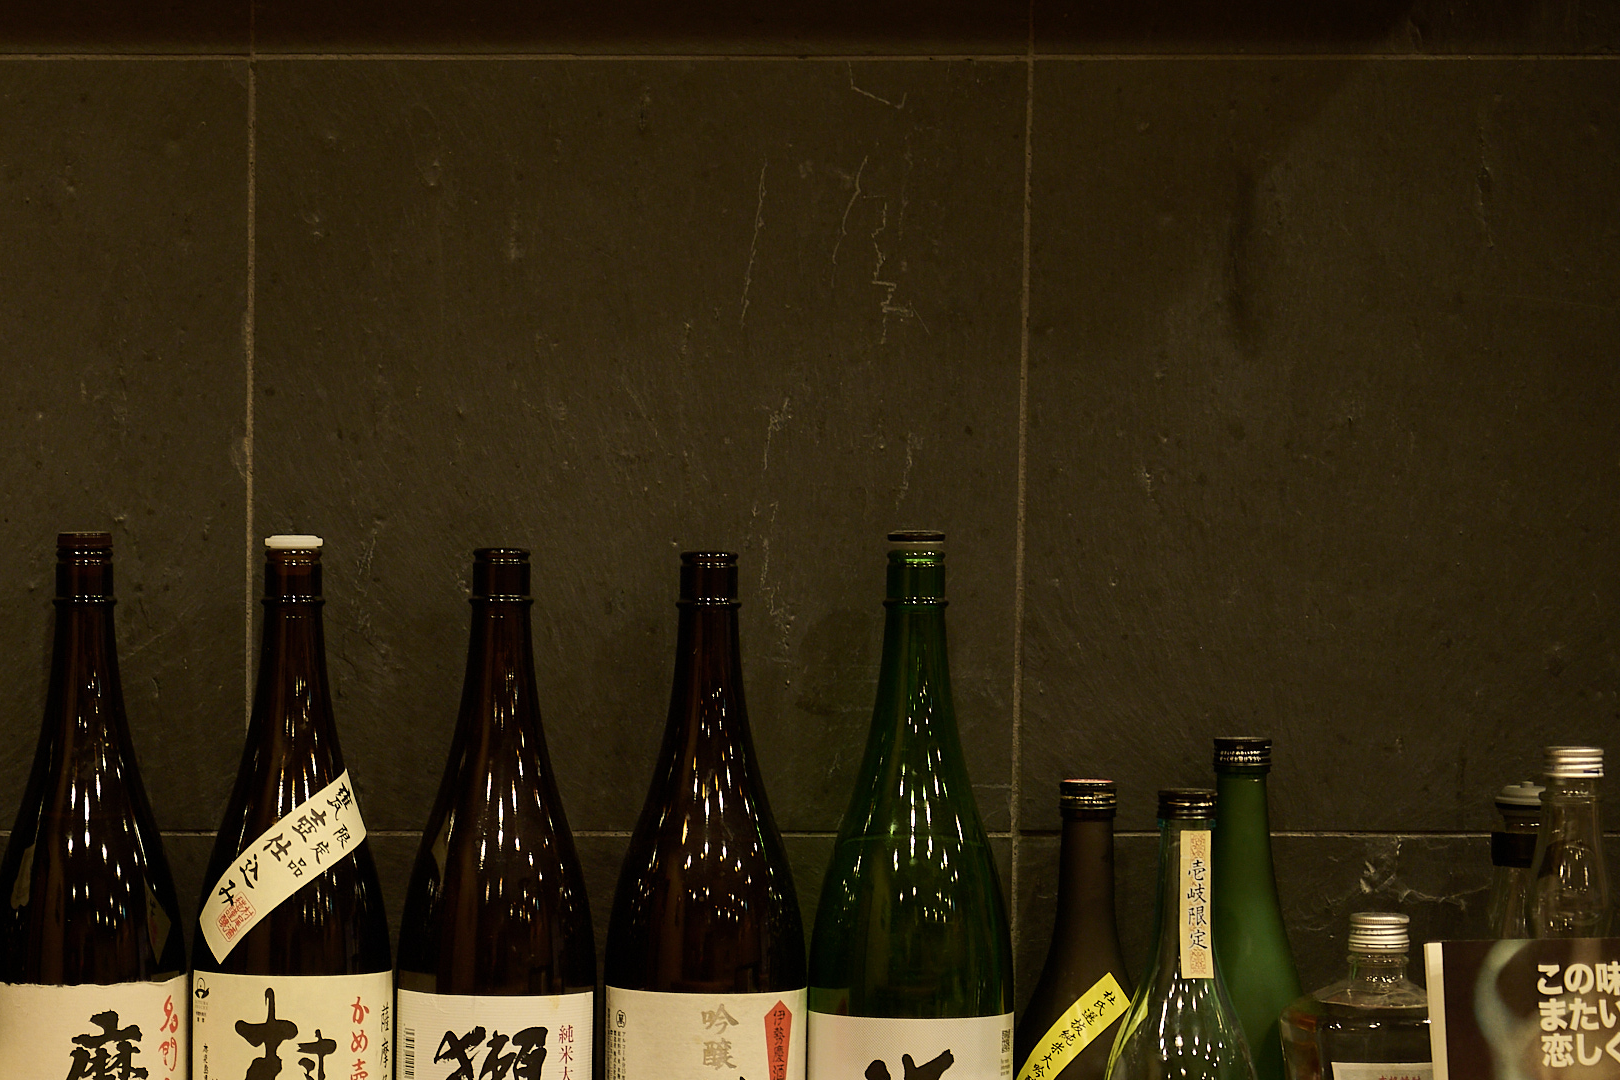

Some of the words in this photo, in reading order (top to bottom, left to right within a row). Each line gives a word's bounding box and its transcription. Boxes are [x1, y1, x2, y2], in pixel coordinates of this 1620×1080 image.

[286, 824, 351, 878] 限定品
[1186, 859, 1208, 951] 壱岐限定
[1537, 960, 1620, 996] この味
[701, 1003, 740, 1071] 吟醸
[1541, 1032, 1620, 1068] 恋しく
